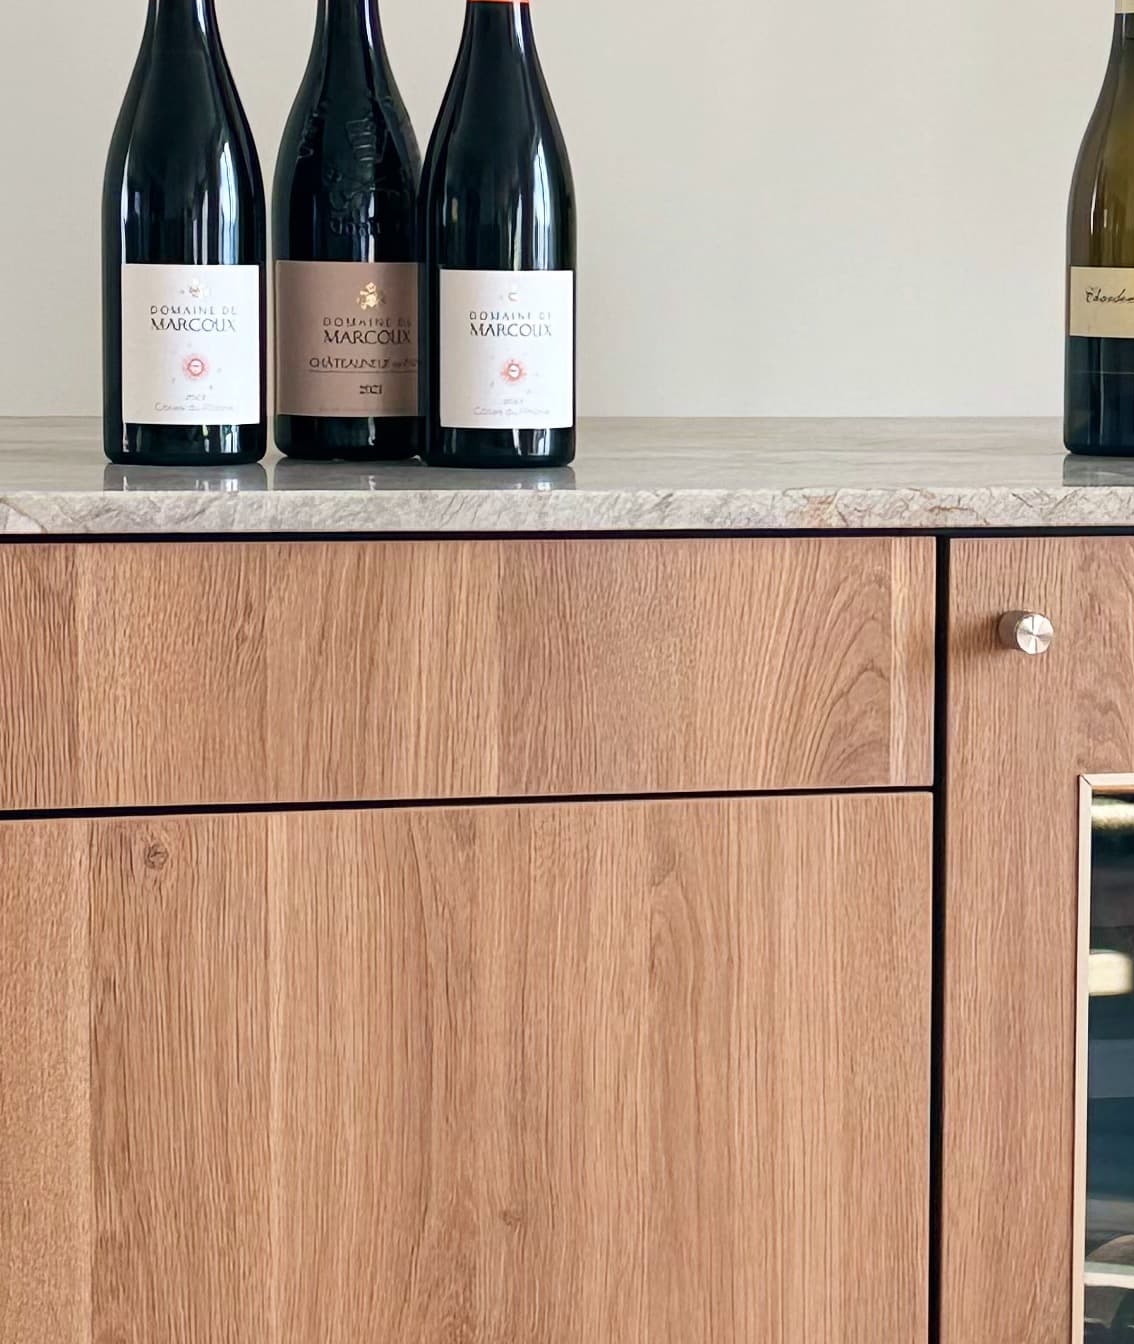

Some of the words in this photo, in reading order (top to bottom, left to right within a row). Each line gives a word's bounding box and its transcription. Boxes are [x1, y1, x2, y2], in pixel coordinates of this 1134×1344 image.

[150, 305, 215, 315] DOMAINE
[469, 311, 531, 321] DOMAINE
[151, 318, 236, 332] MARCOUX
[323, 317, 391, 327] DOMAINE
[470, 323, 552, 337] MARCOUX
[323, 329, 411, 345] MARCOUX
